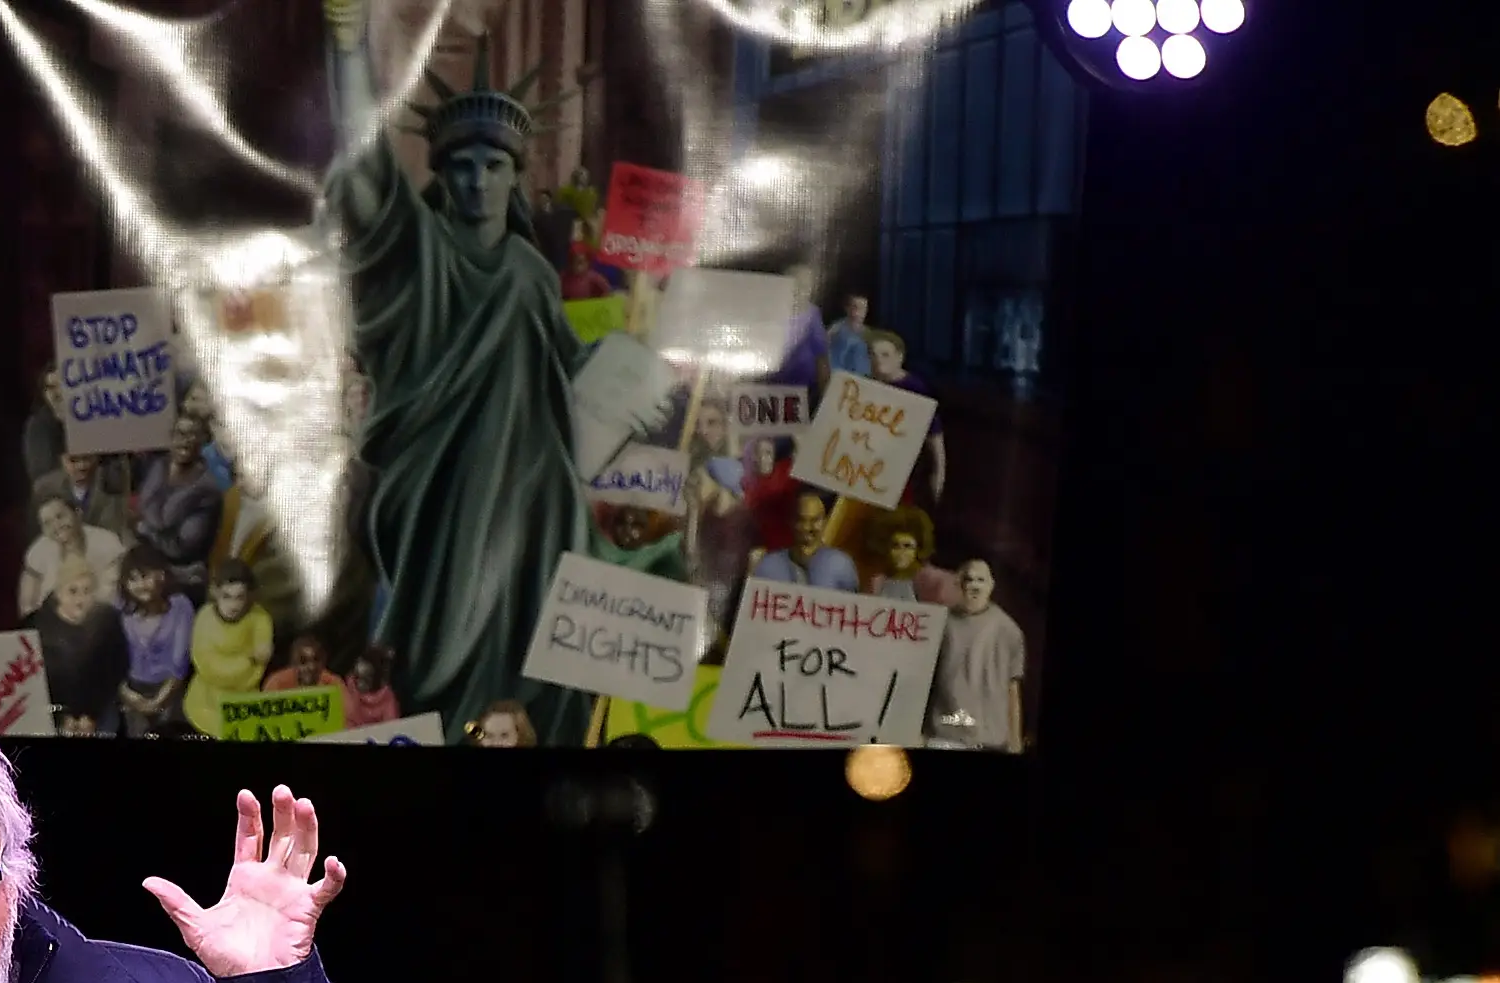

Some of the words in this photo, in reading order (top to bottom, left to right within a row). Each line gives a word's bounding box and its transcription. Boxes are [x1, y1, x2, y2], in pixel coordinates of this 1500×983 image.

[67, 313, 138, 348] STOP
[64, 341, 171, 387] CLIMATE
[72, 387, 169, 421] CHANGE
[738, 395, 801, 425] ONE
[556, 579, 695, 635] IMMIGRANT
[550, 614, 684, 683] RIGHTS
[774, 638, 857, 678] FOR
